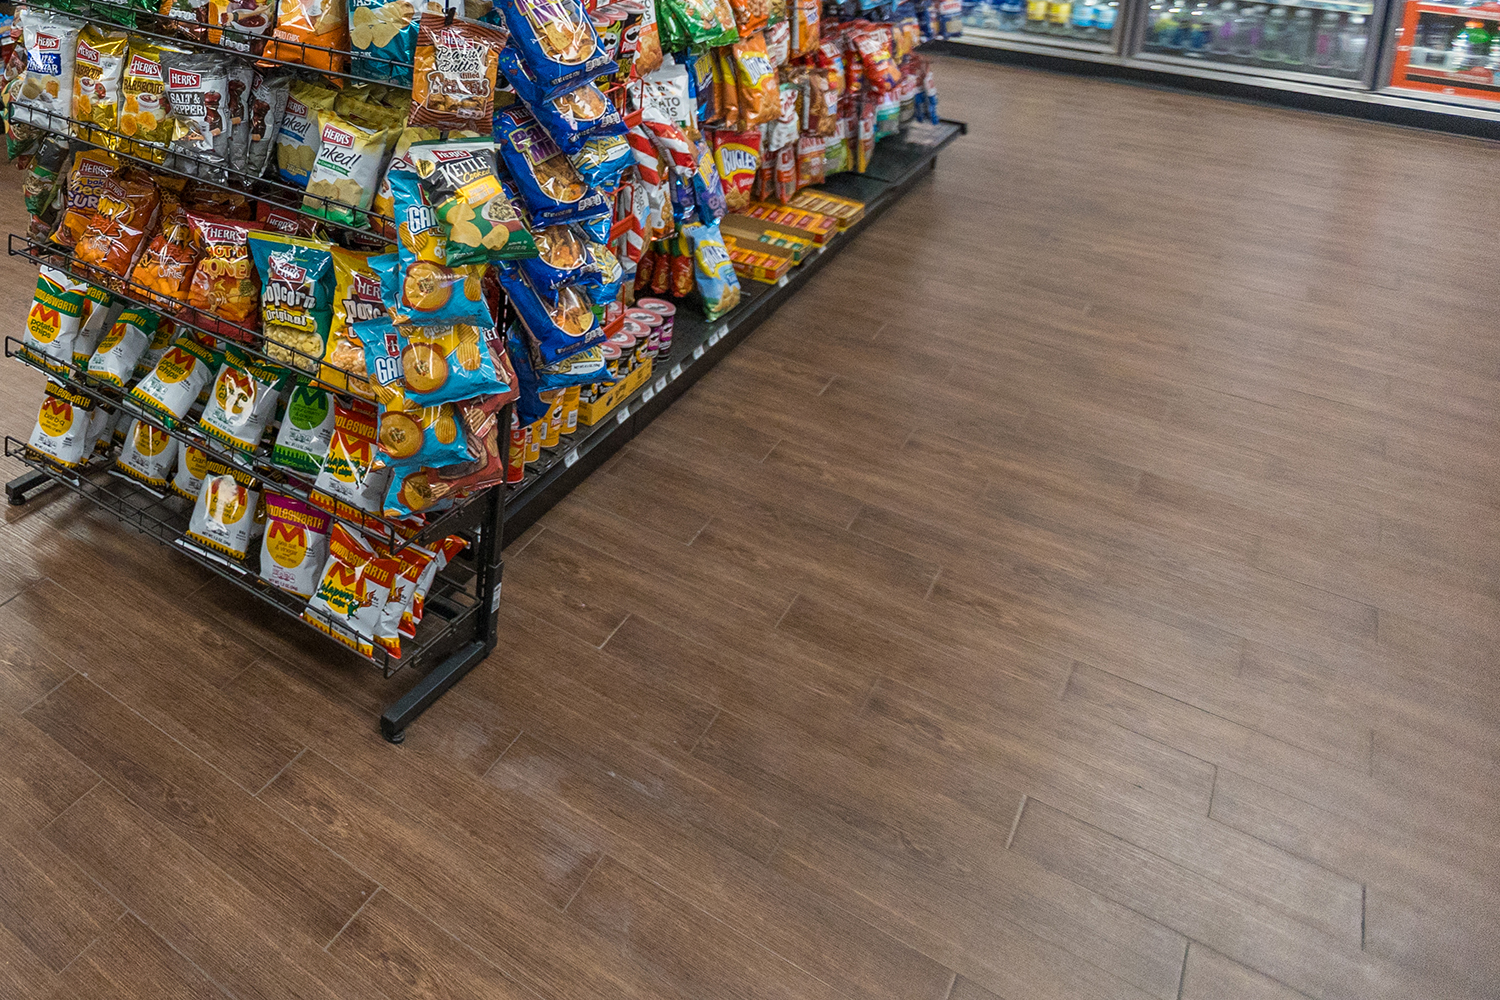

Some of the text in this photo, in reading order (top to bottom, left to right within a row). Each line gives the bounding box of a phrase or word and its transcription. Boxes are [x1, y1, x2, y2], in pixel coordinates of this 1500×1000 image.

[38, 36, 59, 49] HERR'S
[78, 46, 98, 62] HERR'S
[437, 45, 484, 62] Peanut
[130, 60, 159, 74] HERR'S
[438, 58, 482, 73] Butter
[123, 79, 164, 94] BARBECUE
[171, 72, 198, 86] HERR'S
[170, 92, 201, 105] SALT &
[172, 104, 207, 117] PEPPER
[287, 100, 308, 117] HERR'S
[324, 129, 351, 145] HERR'S
[320, 146, 362, 170] aked!
[722, 148, 757, 175] BUGLES
[438, 156, 492, 189] KETTLE
[462, 168, 491, 184] Cooked
[210, 227, 244, 241] HERR'S
[263, 283, 316, 309] popcorn
[265, 308, 307, 327] Original
[30, 319, 55, 333] potato
[31, 326, 51, 339] chips
[158, 365, 179, 380] chips
[161, 358, 185, 375] potato
